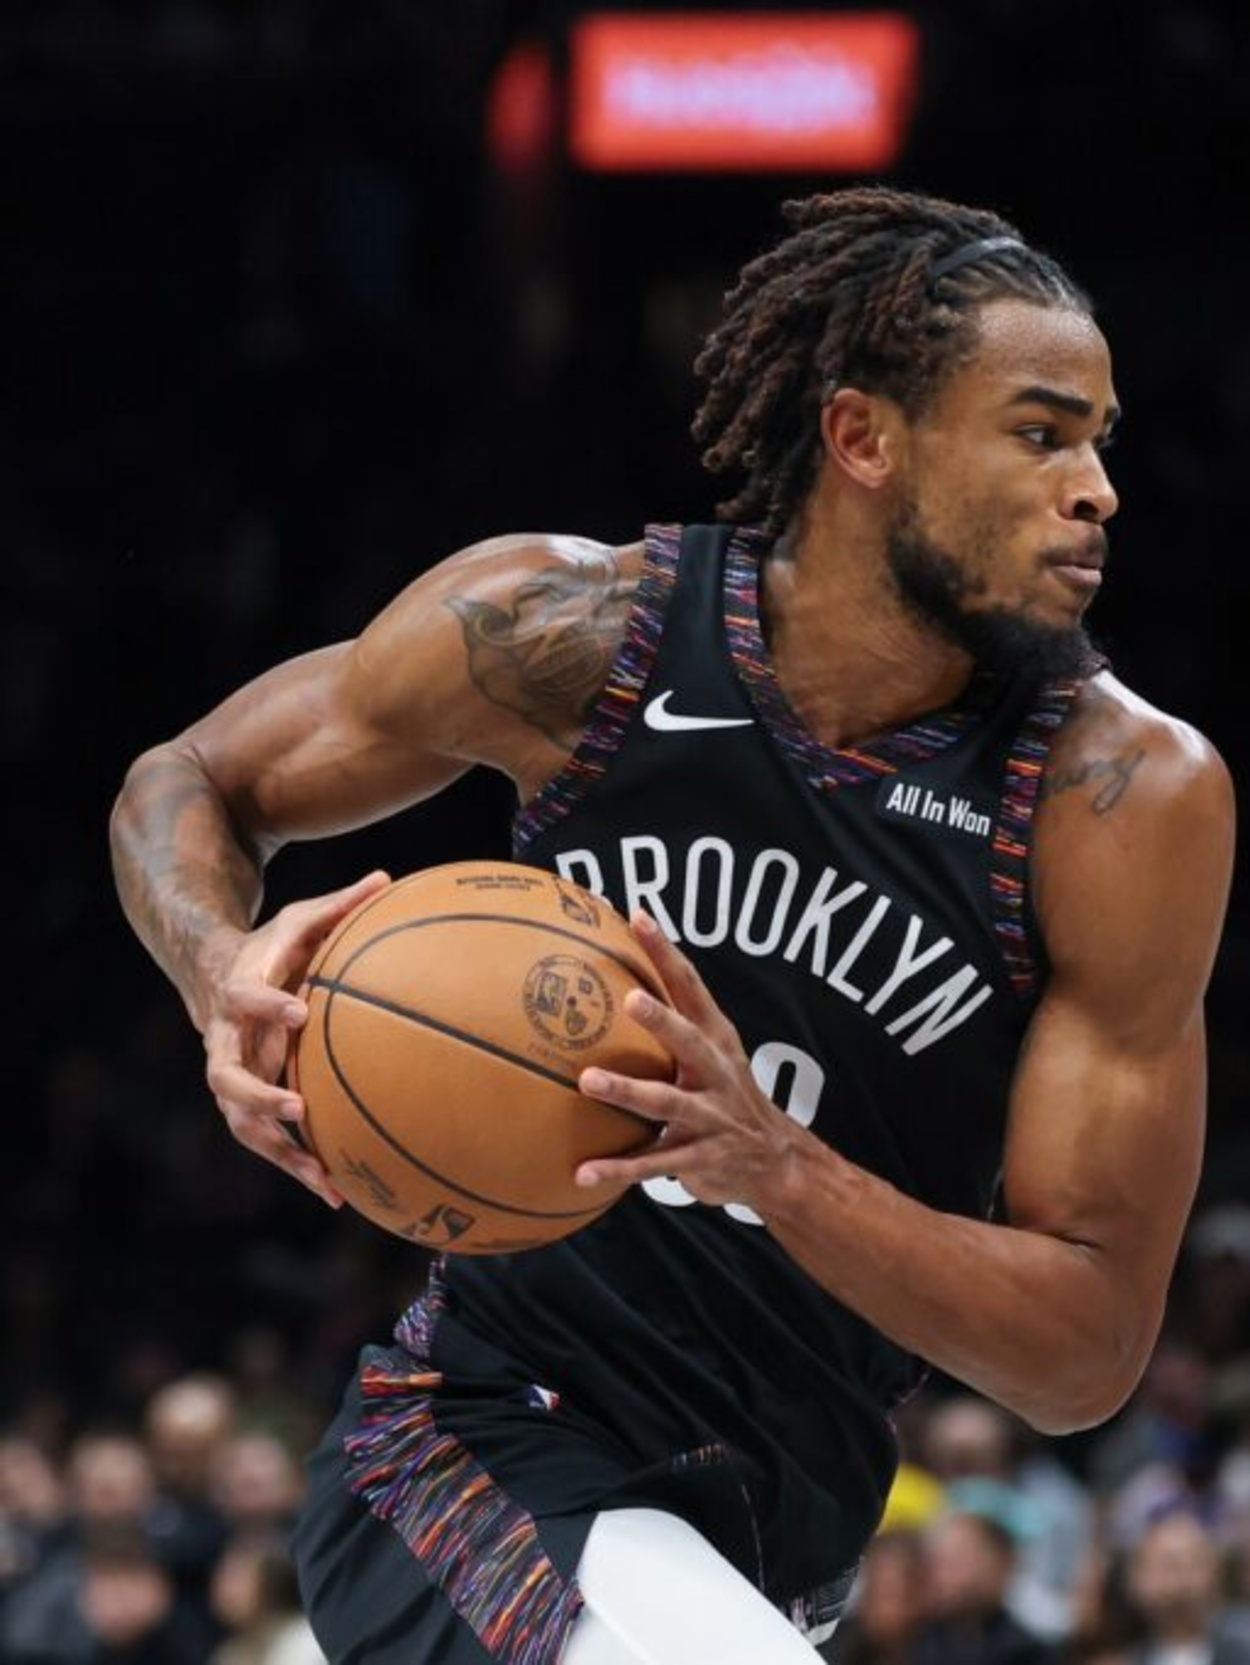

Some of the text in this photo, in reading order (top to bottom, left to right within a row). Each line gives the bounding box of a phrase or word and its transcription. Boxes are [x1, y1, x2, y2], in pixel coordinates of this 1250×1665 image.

[886, 783, 991, 836] All In Won
